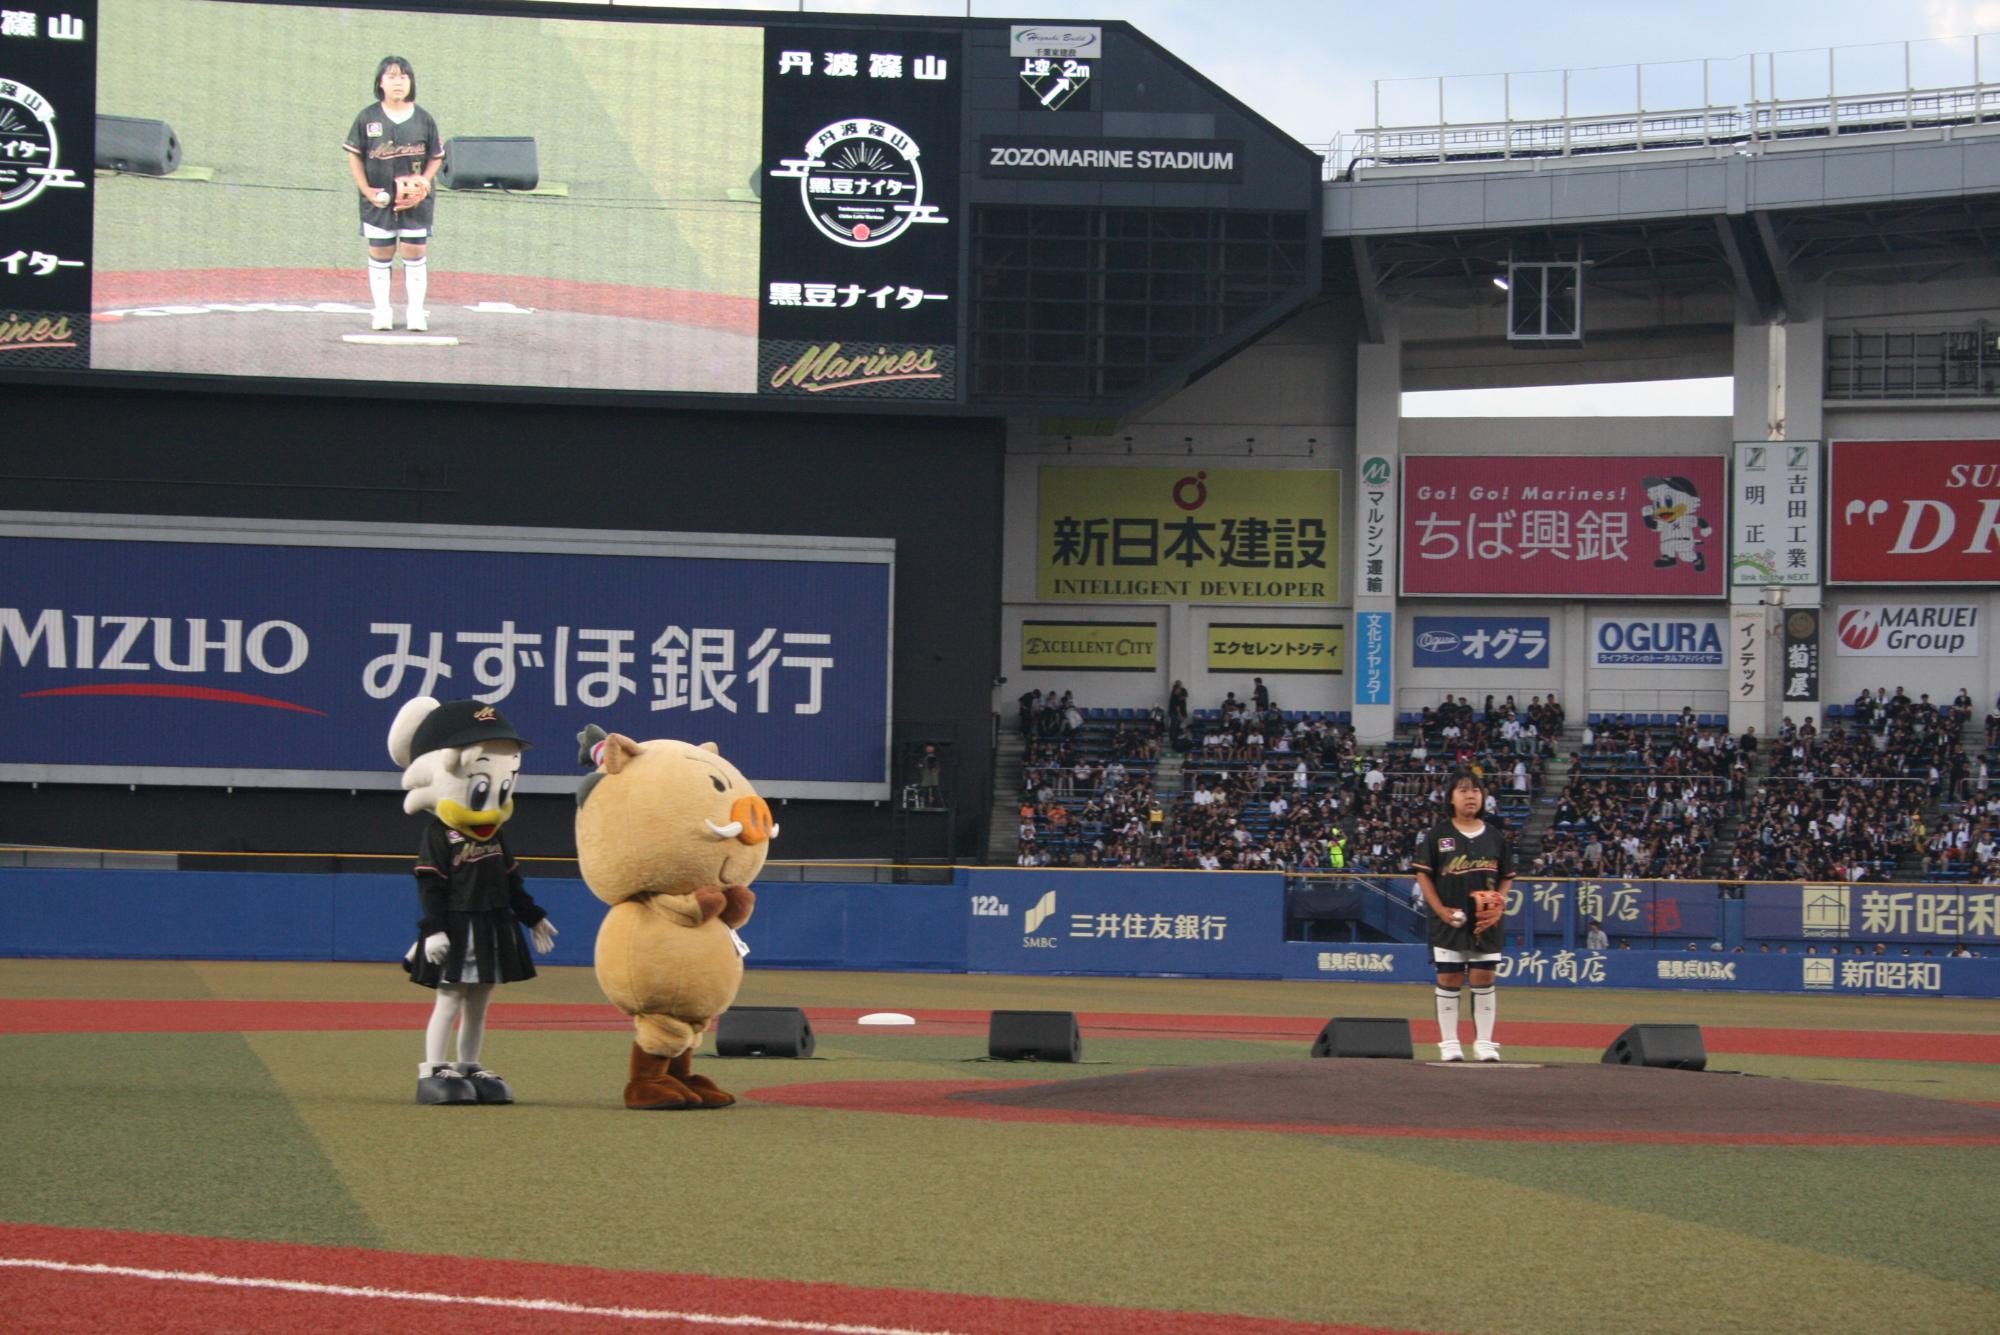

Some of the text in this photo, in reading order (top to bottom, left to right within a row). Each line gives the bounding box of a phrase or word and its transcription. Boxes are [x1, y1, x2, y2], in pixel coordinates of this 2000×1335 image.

[779, 51, 947, 80] 丹波篠山
[1020, 58, 1090, 78] 上空 2m
[990, 147, 1233, 170] ZOZOMARINE STADIUM
[808, 177, 916, 196] 黒豆ナイター
[769, 282, 949, 310] 黒豆ナイター
[770, 342, 943, 391] Marines
[1946, 464, 2000, 488] SU
[1417, 486, 1627, 501] Go! Go! Marines!
[1787, 474, 1808, 568] 吉田工業
[1052, 515, 1327, 569] 新日本建設
[1415, 509, 1630, 562] ちば興銀
[1054, 579, 1325, 597] INTELLIGENT DEVELOPER
[1880, 607, 1977, 627] MARUEI
[0, 608, 309, 675] MIZUHO
[1213, 641, 1338, 657] エクセレントシティ
[1462, 628, 1547, 660] オグラ
[1598, 622, 1722, 652] OGURA
[1887, 630, 1965, 653] Group
[362, 620, 834, 715] みずほ銀行
[1740, 623, 1756, 696] イノテック
[1069, 913, 1227, 940] 三井住友銀行
[1023, 937, 1057, 948] SMBC
[1841, 959, 1941, 990] 新昭和
